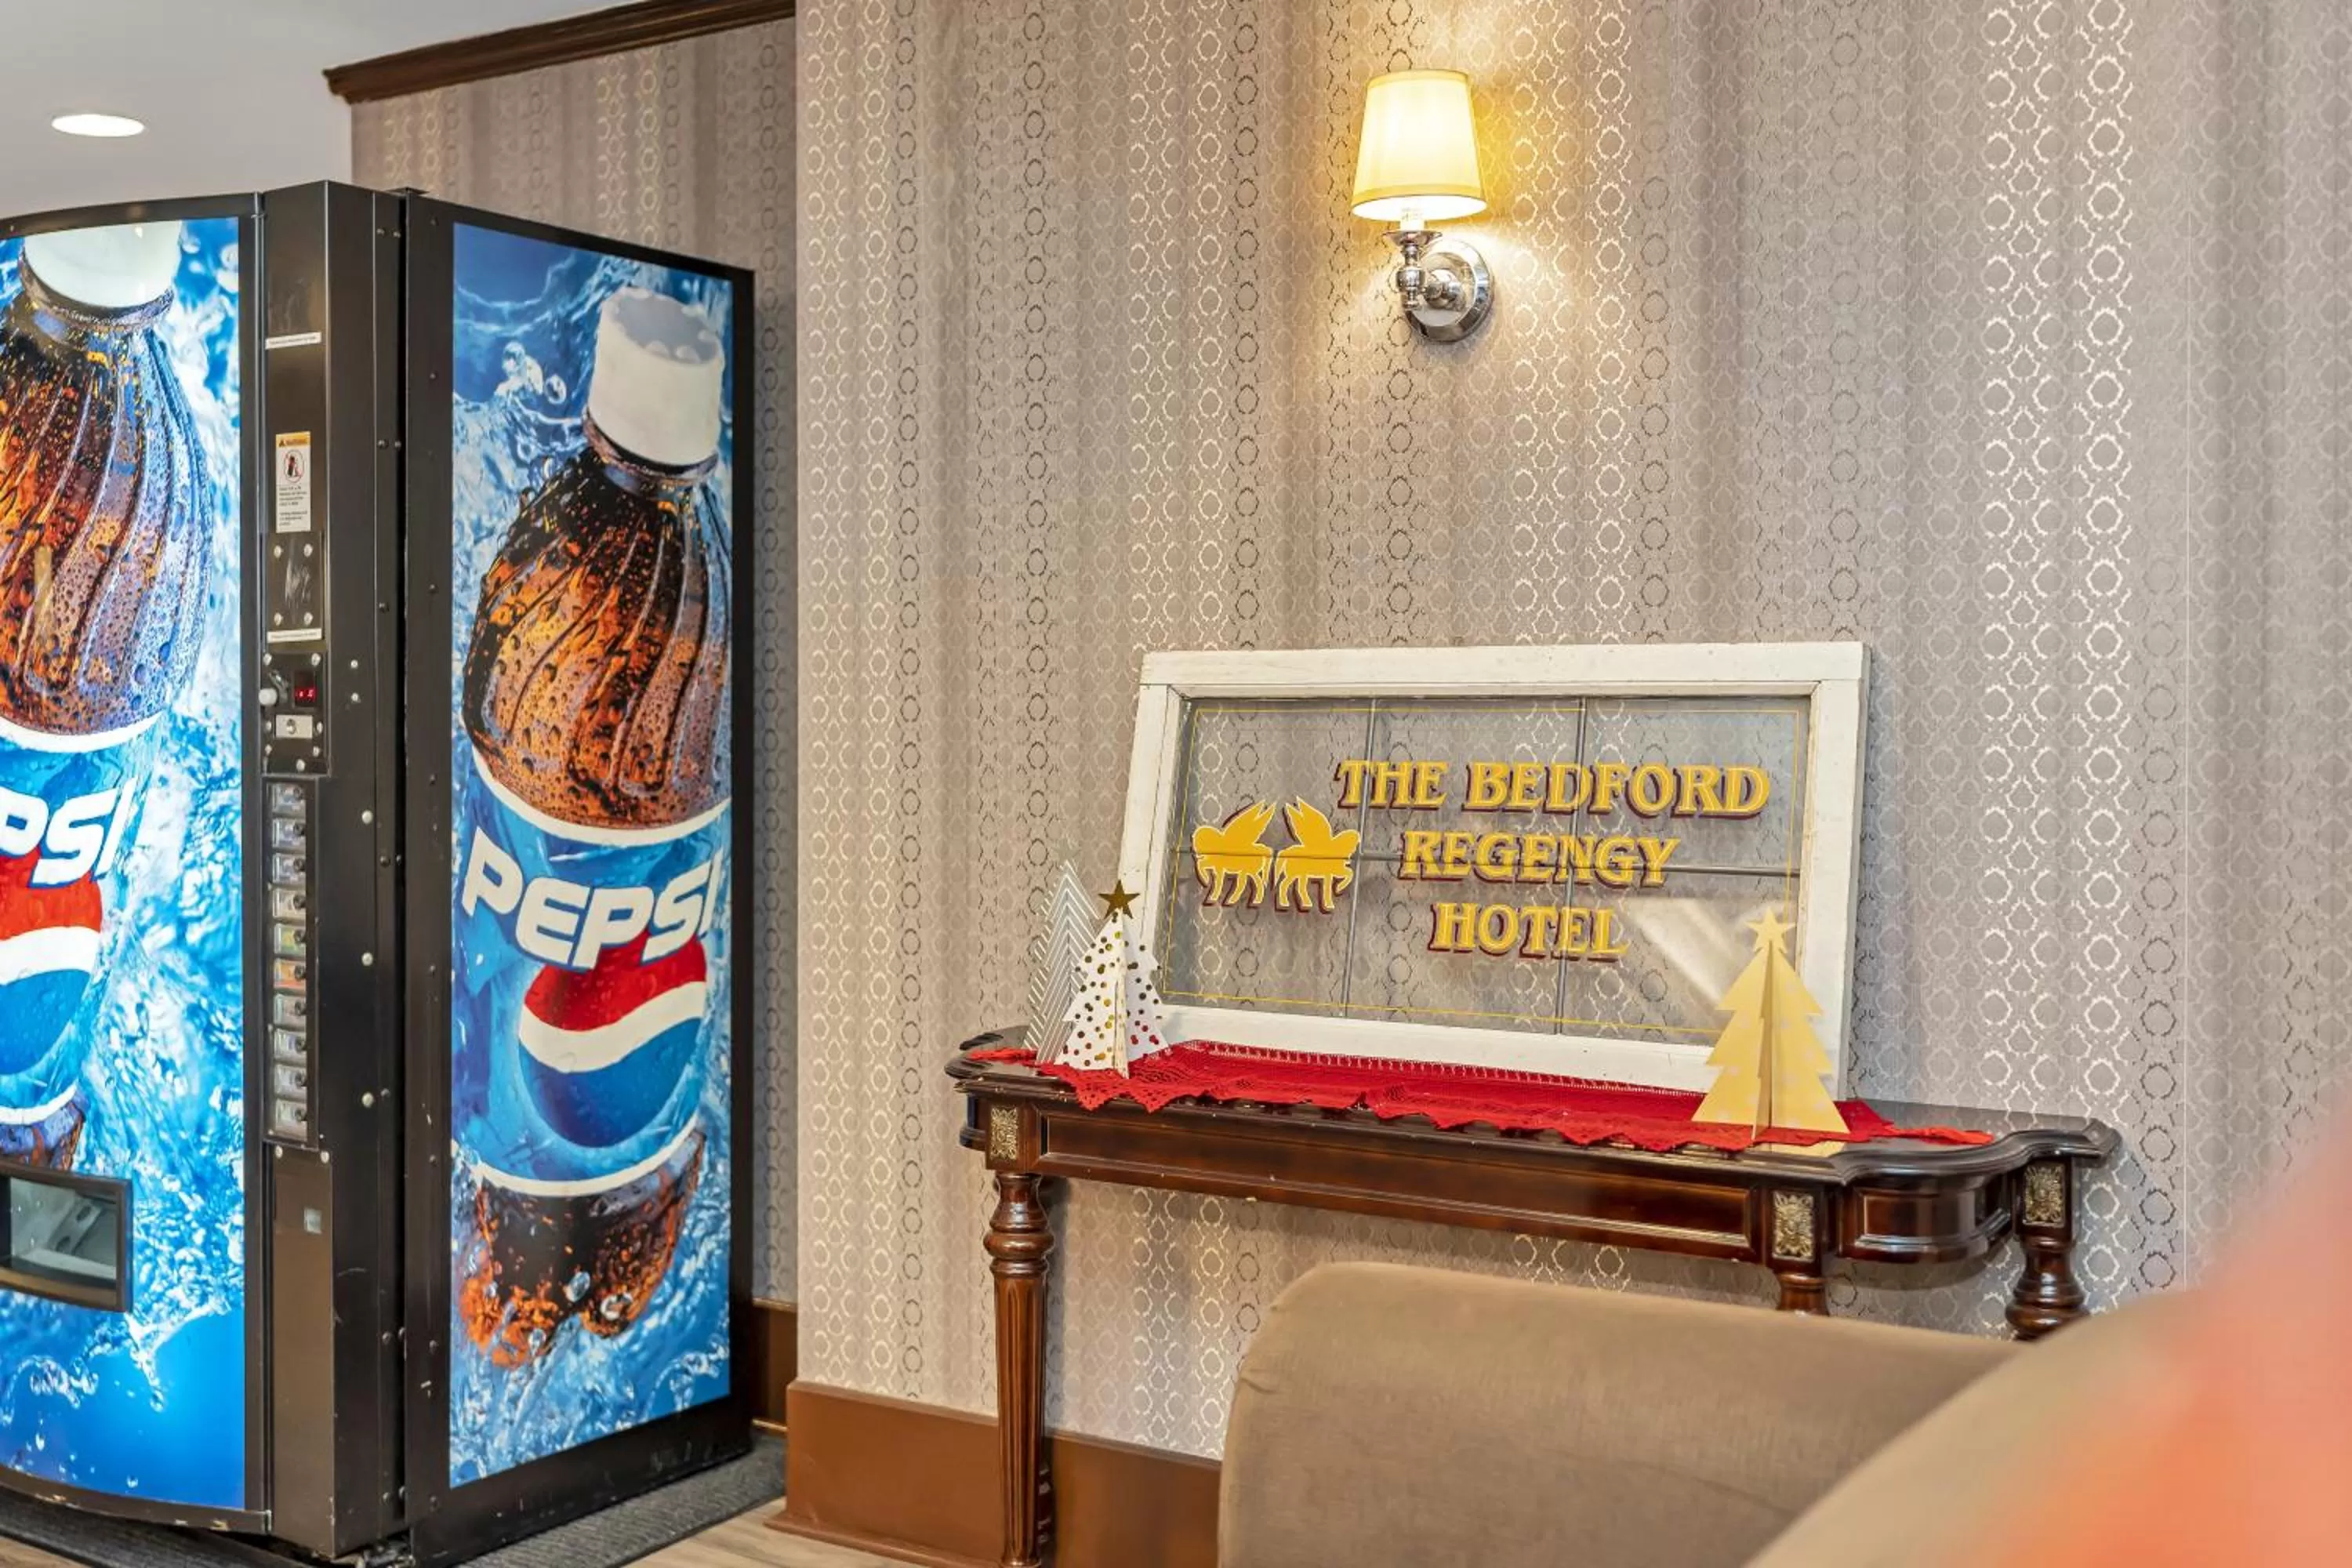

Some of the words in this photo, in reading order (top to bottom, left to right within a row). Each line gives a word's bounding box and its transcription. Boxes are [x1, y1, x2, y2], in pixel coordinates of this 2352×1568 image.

[1334, 760, 1449, 810] THE
[1461, 762, 1769, 818] BEDFORD
[462, 827, 723, 970] PEPSI
[1428, 902, 1630, 963] HOTEL
